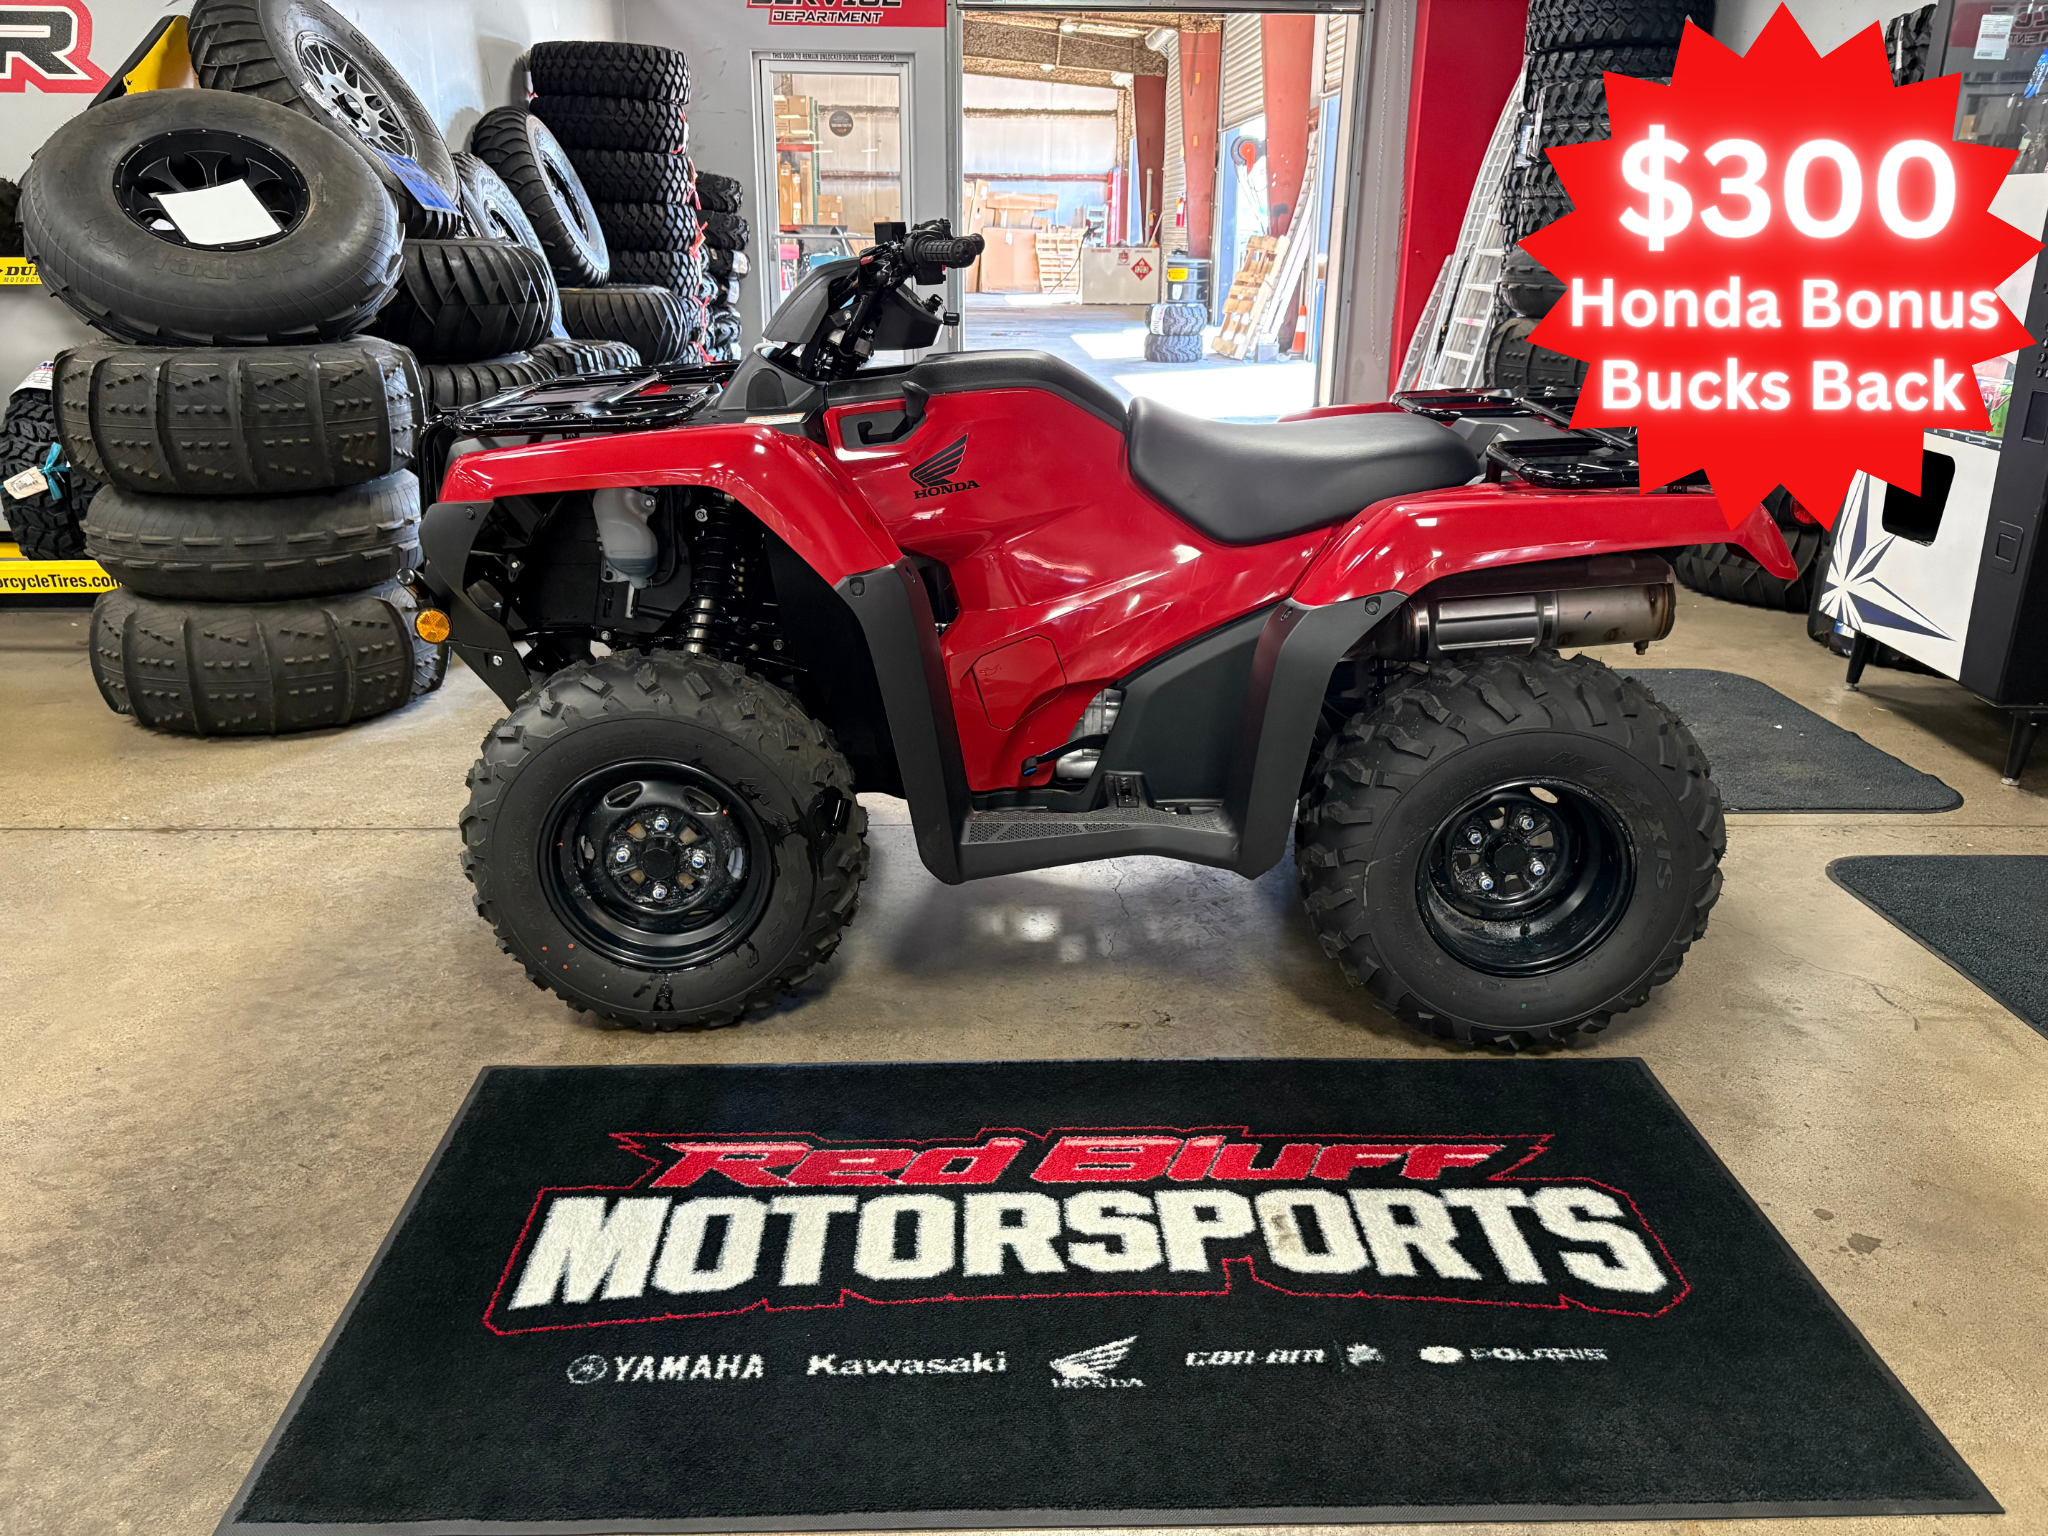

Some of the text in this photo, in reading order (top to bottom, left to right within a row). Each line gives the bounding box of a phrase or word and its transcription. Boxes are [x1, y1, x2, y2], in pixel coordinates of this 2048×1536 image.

[772, 10, 883, 24] DEPARTMENT
[914, 479, 981, 499] HONDA
[649, 1137, 1027, 1188] Red
[507, 1188, 1668, 1311] MOTORSPORTS
[614, 1353, 765, 1383] YAMAHA
[806, 1351, 1008, 1376] Kawasaki
